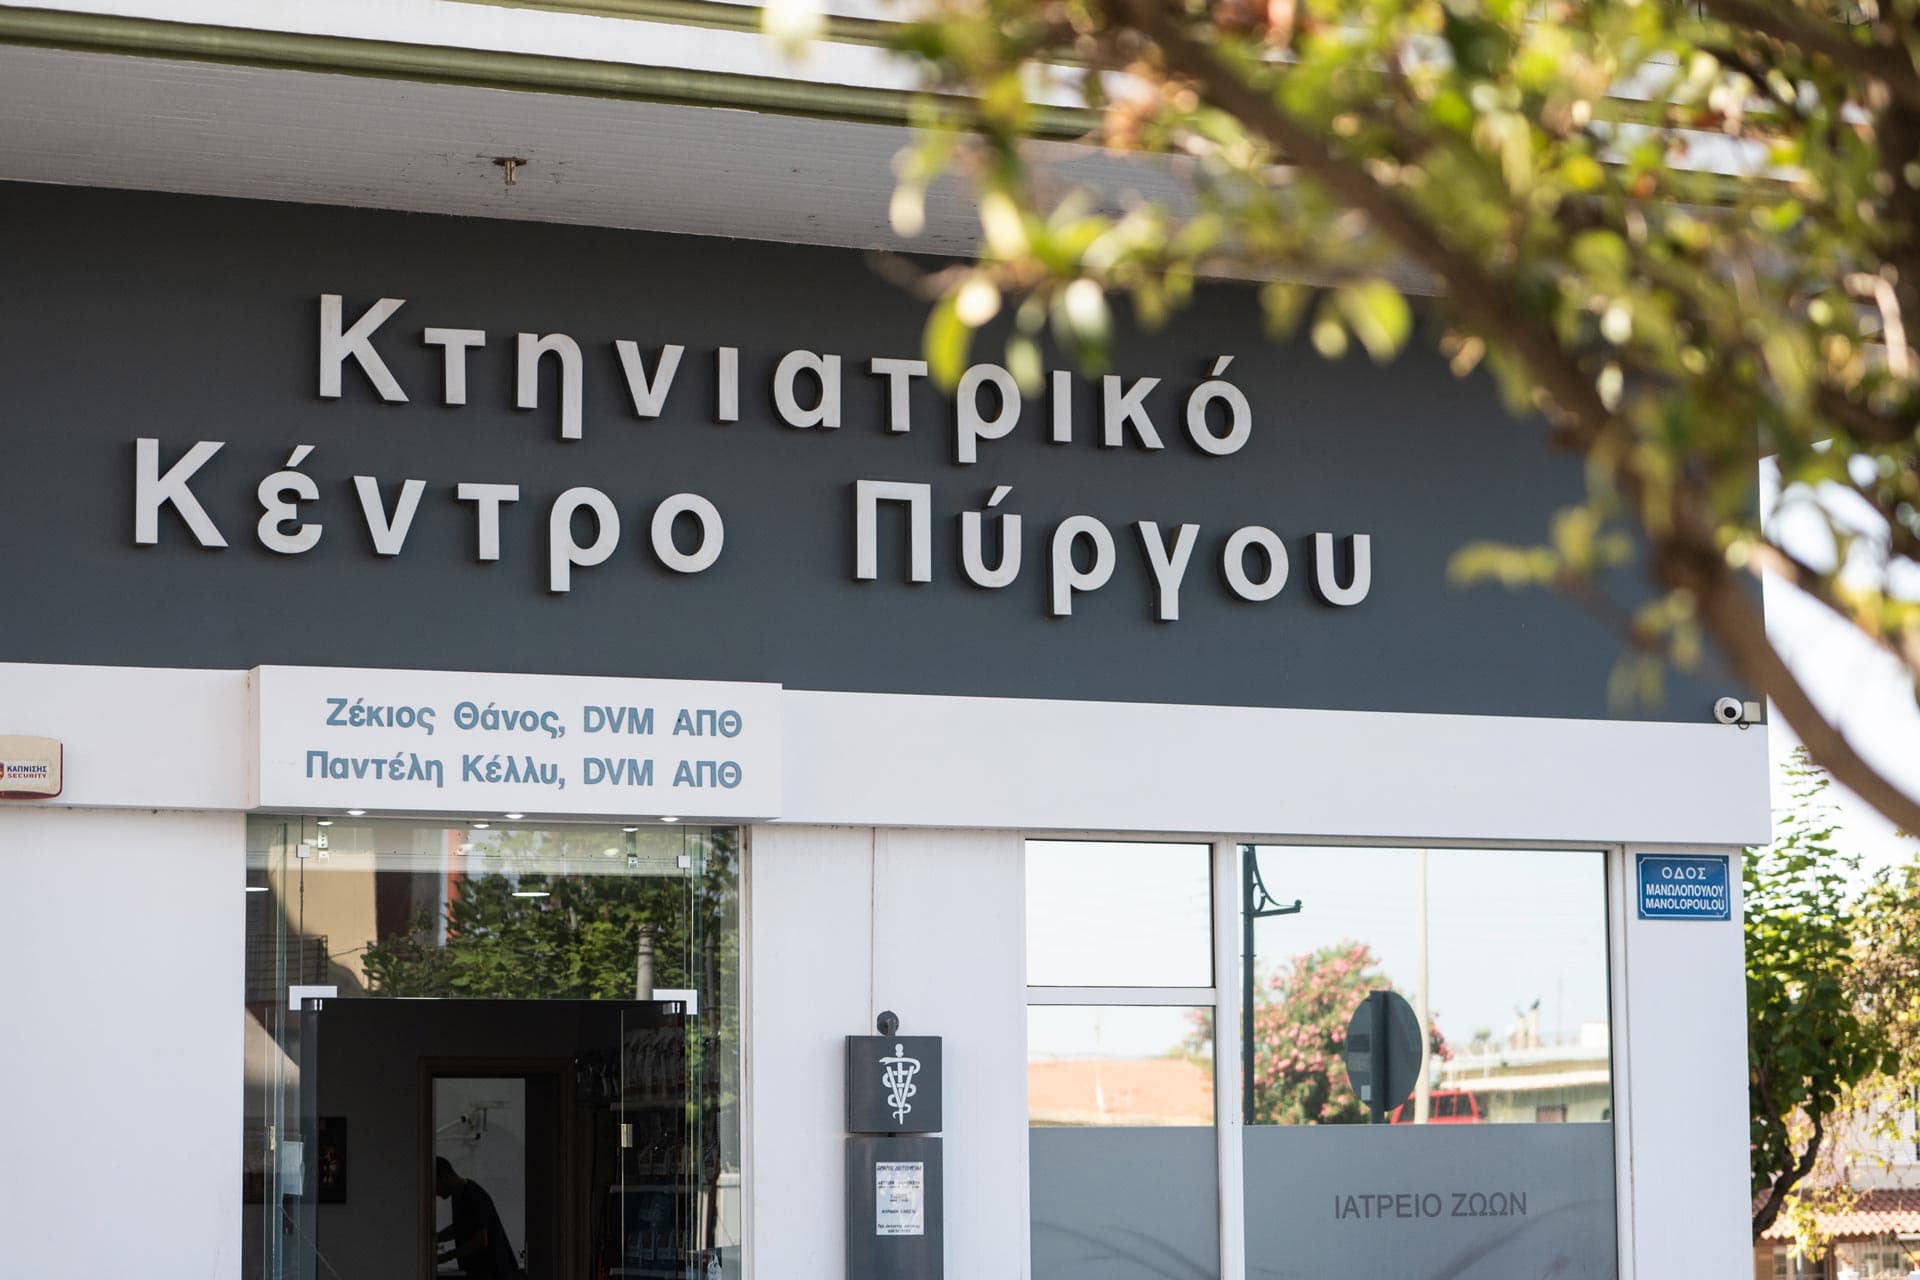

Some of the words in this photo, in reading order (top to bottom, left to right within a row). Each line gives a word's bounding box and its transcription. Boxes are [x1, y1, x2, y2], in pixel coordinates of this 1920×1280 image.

[317, 293, 1253, 464] Κτηνιατρικό
[134, 437, 725, 592] Κέντρο
[854, 479, 1372, 621] Πύργου
[326, 697, 436, 736] Ζέκιος
[453, 701, 566, 739] Θάνος,
[583, 705, 655, 736] DVM
[672, 708, 743, 738] ΑΠΘ
[306, 750, 443, 788] Παντέλη
[462, 754, 566, 790] Κέλλυ,
[583, 757, 655, 787] DVM
[672, 760, 743, 789] ΑΠΘ
[1662, 866, 1706, 880] ΟΔΟΣ
[1645, 883, 1724, 897] ΜΑΝΩΛΟΠΟΥΛΟΥ
[1645, 898, 1725, 911] MANOLOPOULOU
[1335, 1193, 1442, 1219] ΙΑΤΡΕΙΟ
[1451, 1192, 1527, 1217] ΖΩΩΝ
